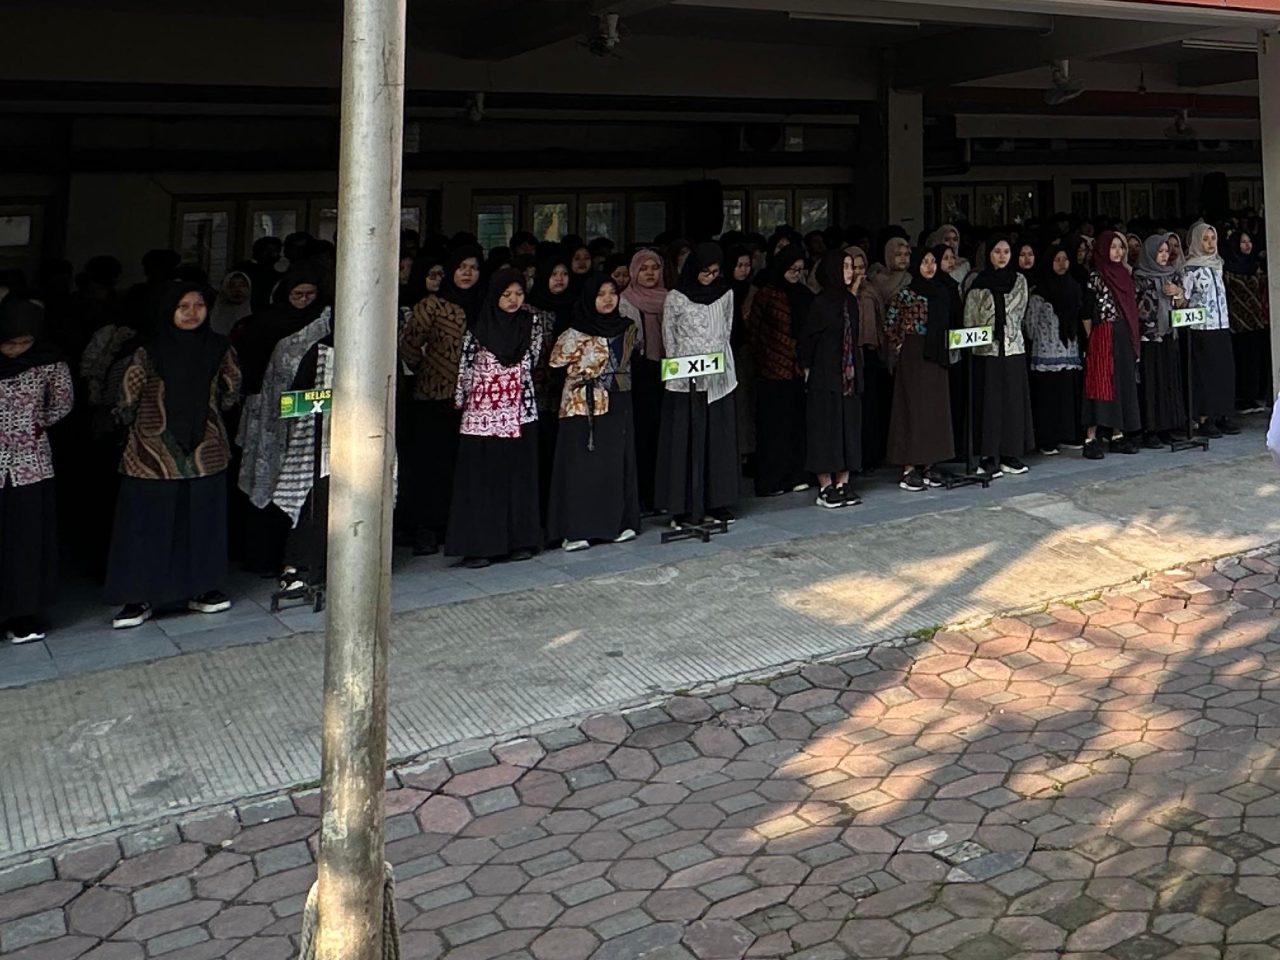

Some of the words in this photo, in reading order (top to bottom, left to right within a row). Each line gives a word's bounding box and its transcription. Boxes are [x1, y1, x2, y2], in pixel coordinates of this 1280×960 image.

[1185, 311, 1203, 322] XI-3
[966, 330, 988, 344] XI-2
[687, 356, 719, 374] XI-1
[304, 390, 331, 400] KELAS
[310, 400, 324, 413] X
